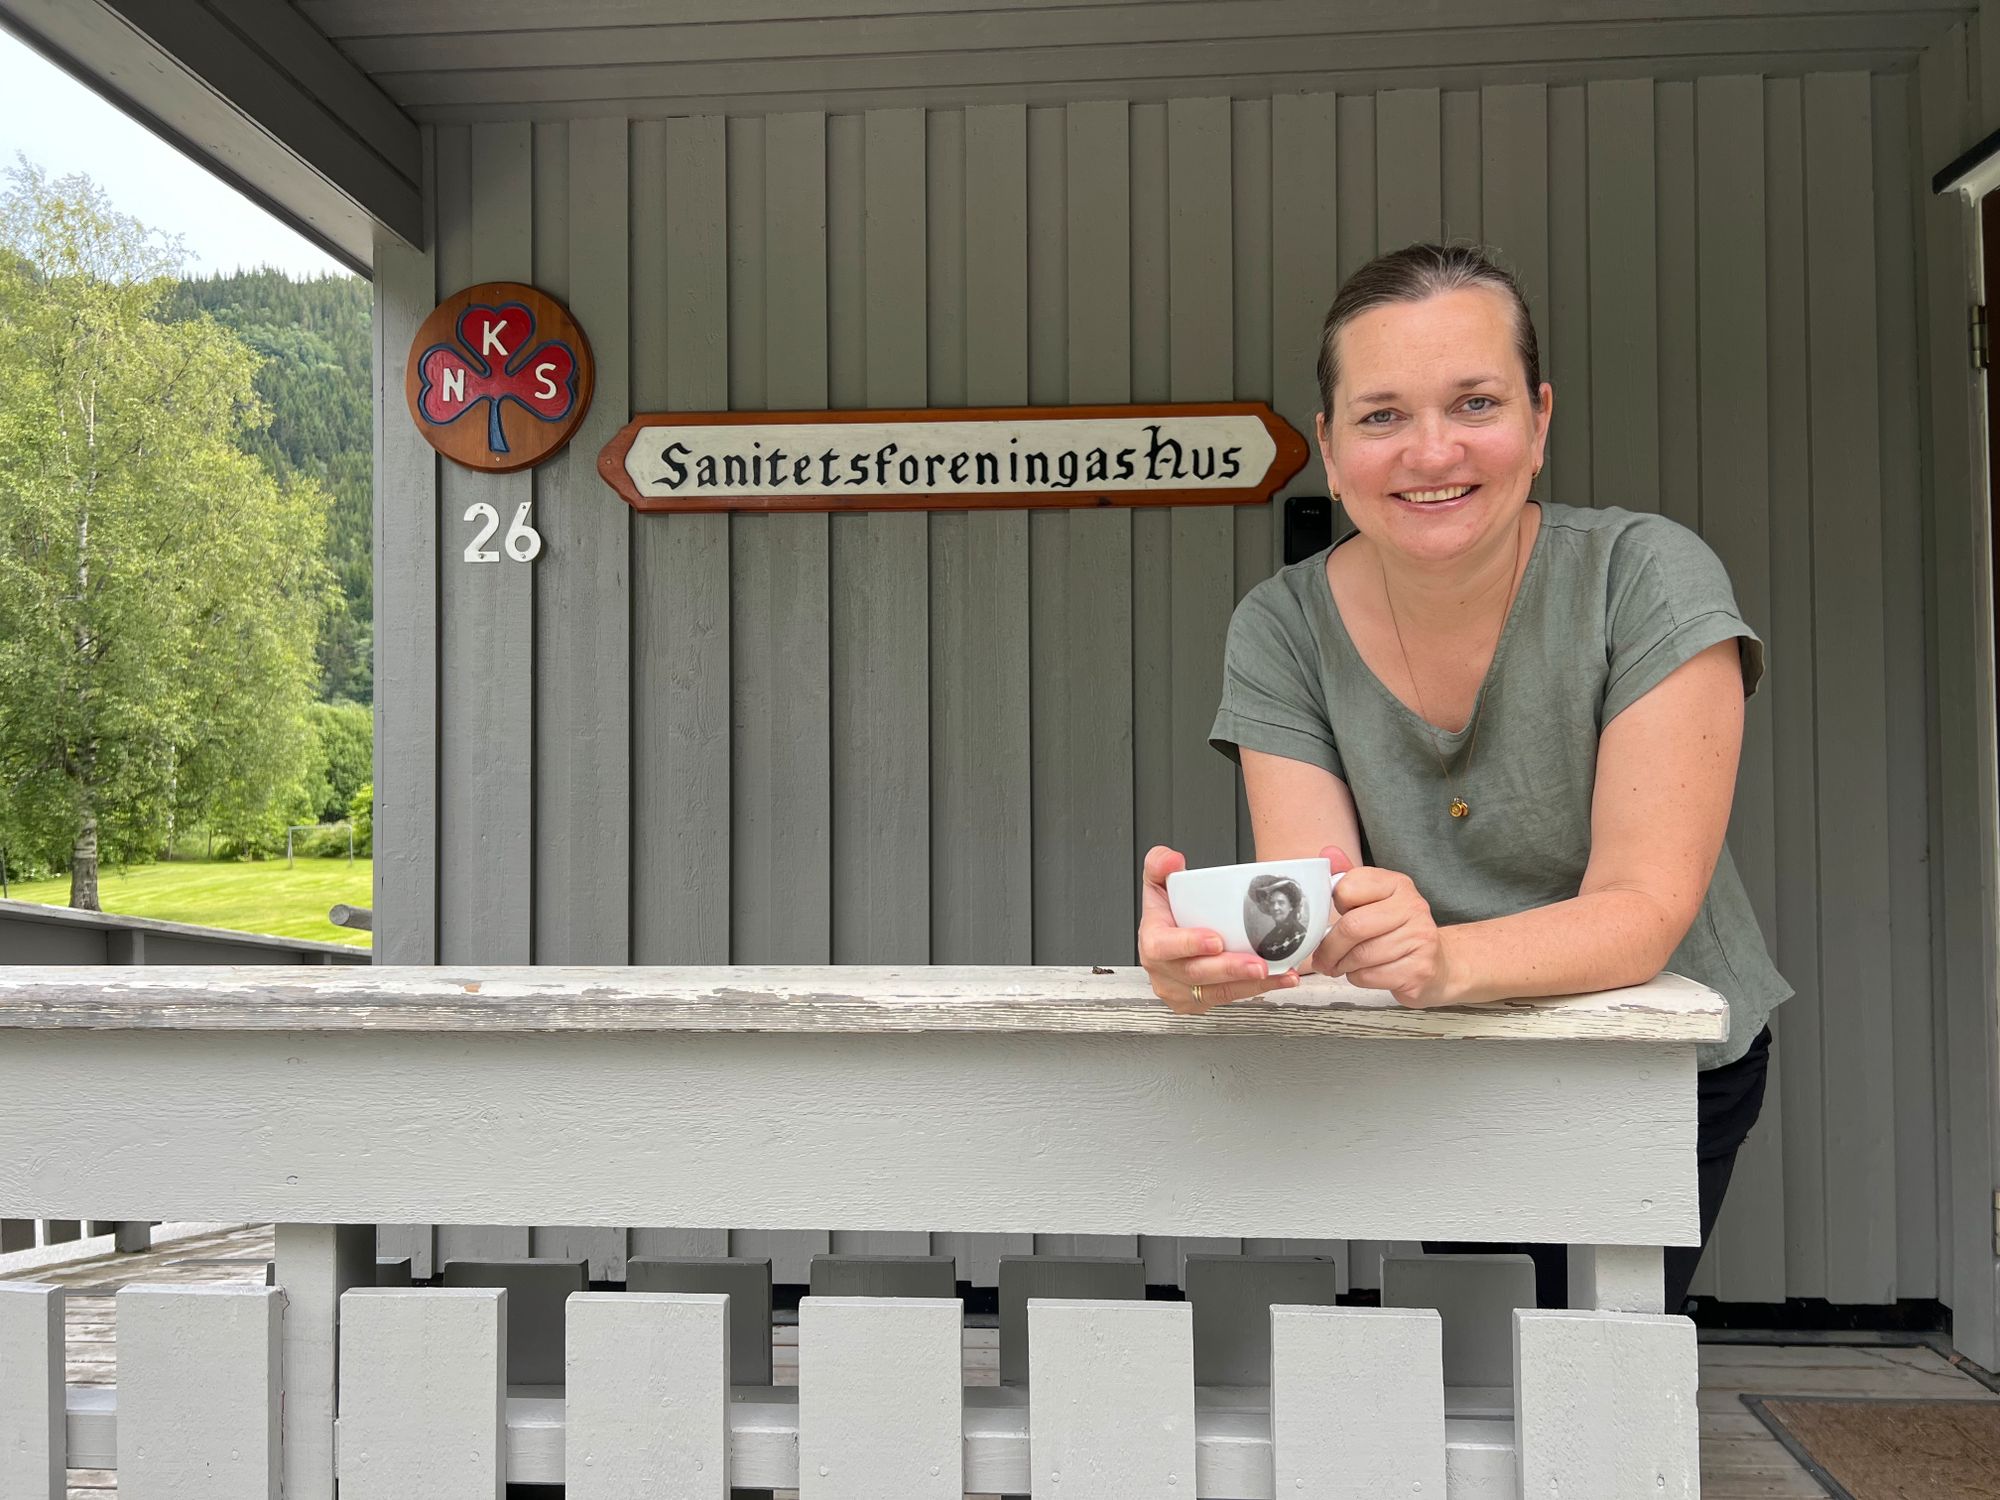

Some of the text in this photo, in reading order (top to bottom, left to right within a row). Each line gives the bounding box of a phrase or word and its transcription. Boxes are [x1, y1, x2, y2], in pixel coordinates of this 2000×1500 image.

[482, 319, 509, 356] K
[442, 367, 465, 402] N
[534, 362, 558, 400] S
[463, 501, 542, 563] 26
